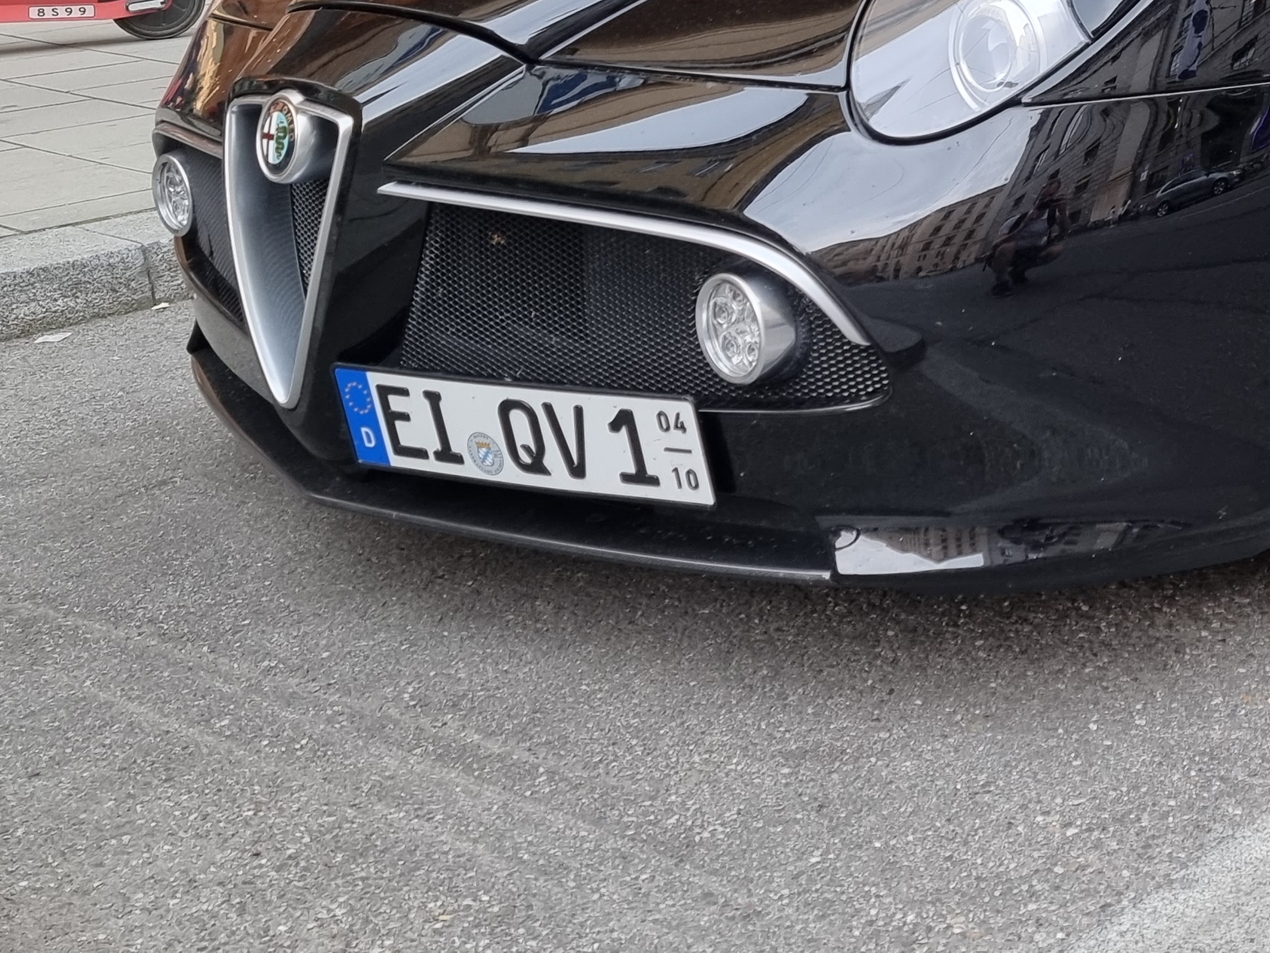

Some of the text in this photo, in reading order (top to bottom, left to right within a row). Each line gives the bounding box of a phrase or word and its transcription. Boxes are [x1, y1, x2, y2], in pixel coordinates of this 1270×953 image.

[656, 410, 687, 434] 04
[360, 427, 376, 448] D
[375, 383, 465, 465] EI
[498, 399, 587, 480] QV
[607, 408, 661, 487] 1
[671, 467, 700, 490] 10
